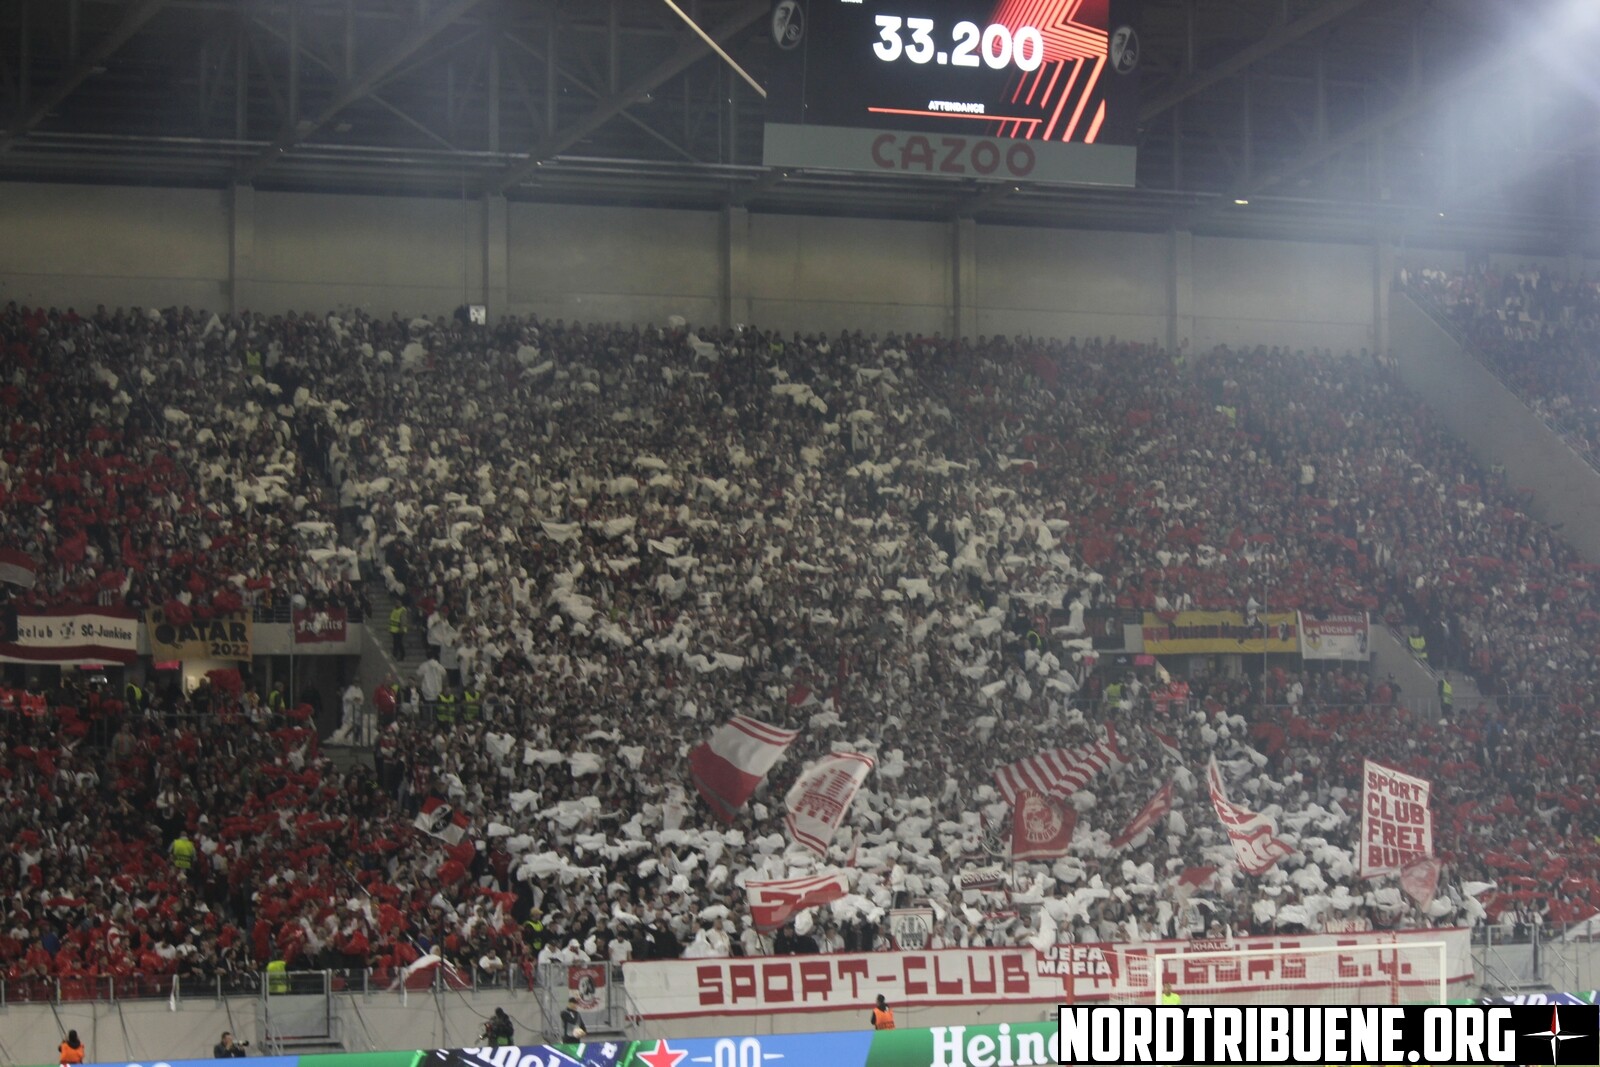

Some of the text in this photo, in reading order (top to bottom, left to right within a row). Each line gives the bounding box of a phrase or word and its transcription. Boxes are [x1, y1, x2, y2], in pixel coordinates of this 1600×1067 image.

[873, 15, 1044, 72] 33.200
[928, 100, 985, 114] ATTENDANCE
[871, 133, 1036, 177] CAZOO
[81, 623, 133, 640] SC-Junkies
[211, 642, 249, 657] 2022
[1367, 771, 1424, 802] SPORT
[1367, 792, 1425, 825] CLUB
[1368, 817, 1426, 851] FREI
[1368, 844, 1424, 869] BUR
[1037, 960, 1112, 976] MAFIA
[1043, 947, 1104, 961] UEFA
[696, 954, 1031, 1006] SPORT-CLUB
